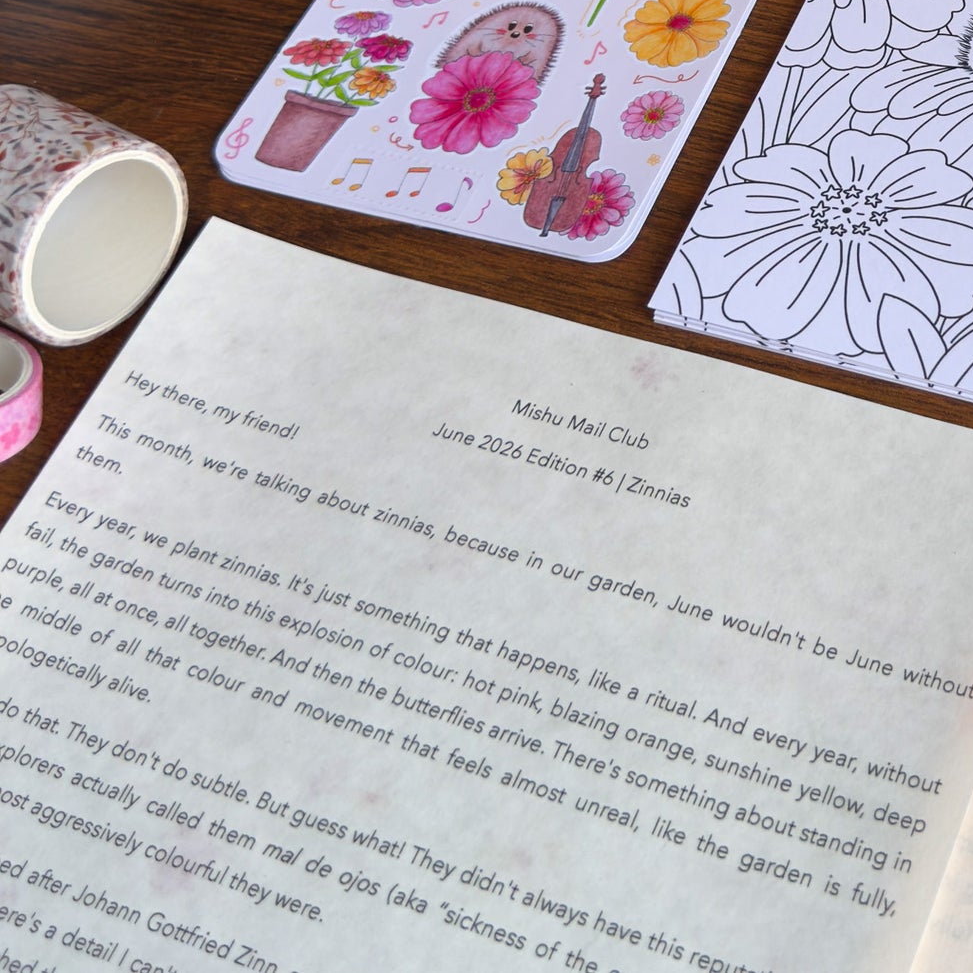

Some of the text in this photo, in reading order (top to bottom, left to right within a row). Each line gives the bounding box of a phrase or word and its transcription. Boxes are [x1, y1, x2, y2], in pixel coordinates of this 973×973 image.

[75, 445, 123, 475] them.
[124, 369, 301, 441] Hey there, my friend!
[431, 422, 476, 447] June
[476, 434, 524, 460] 2026
[525, 447, 589, 479] Edition
[591, 466, 615, 486] #6
[625, 475, 692, 508] Zinnias
[511, 398, 650, 451] Mishu Mail Club
[97, 413, 132, 440] This
[135, 433, 194, 466] month,
[202, 456, 249, 481] we're
[254, 470, 312, 504] talking
[316, 489, 371, 517] about
[372, 507, 436, 540] zinnias,
[443, 524, 520, 563] because
[525, 550, 544, 570] in
[550, 562, 585, 582] our
[586, 574, 659, 609] garden,
[666, 594, 714, 622] June
[722, 614, 807, 651] wouldn't
[811, 635, 839, 660] be
[845, 648, 894, 677] June
[24, 520, 927, 838] fail, the garden turns into this explosion of colour: hot pink, blazing orange, sunshine yellow, deep
[44, 490, 943, 796] Every year, we plant zinnias. It's just something that happens, like a ritual. And every year, without
[107, 675, 151, 704] alive.
[0, 557, 913, 874] purple, all at once, all together. And then the butterflies arrive. There's something about standing in
[0, 593, 896, 918] e middle of all that colour and movement that feels almost unreal, like the garden is fully,
[0, 696, 20, 719] do
[22, 707, 60, 735] that.
[66, 720, 111, 756] They
[111, 739, 161, 771] don't
[162, 758, 188, 782] do
[190, 772, 250, 805] subtle.
[255, 790, 291, 818] But
[288, 809, 349, 840] guess
[351, 829, 407, 860] what!
[410, 844, 458, 882] They
[459, 865, 520, 902] didn't
[521, 888, 590, 927] always
[592, 909, 643, 946] have
[647, 931, 685, 961] this
[0, 786, 323, 923] ost aggressively colourful they were.
[70, 772, 142, 811] actually
[145, 800, 206, 830] called
[207, 818, 257, 851] them
[261, 843, 305, 866] mal
[304, 855, 333, 879] de
[338, 870, 382, 897] ojos
[386, 882, 429, 915] (aka
[534, 940, 562, 961] of
[564, 948, 599, 973] the
[0, 859, 279, 973] ed after Johann Gottfried Zinn
[43, 924, 58, 940] a
[60, 927, 120, 963] detail
[117, 948, 130, 967] I
